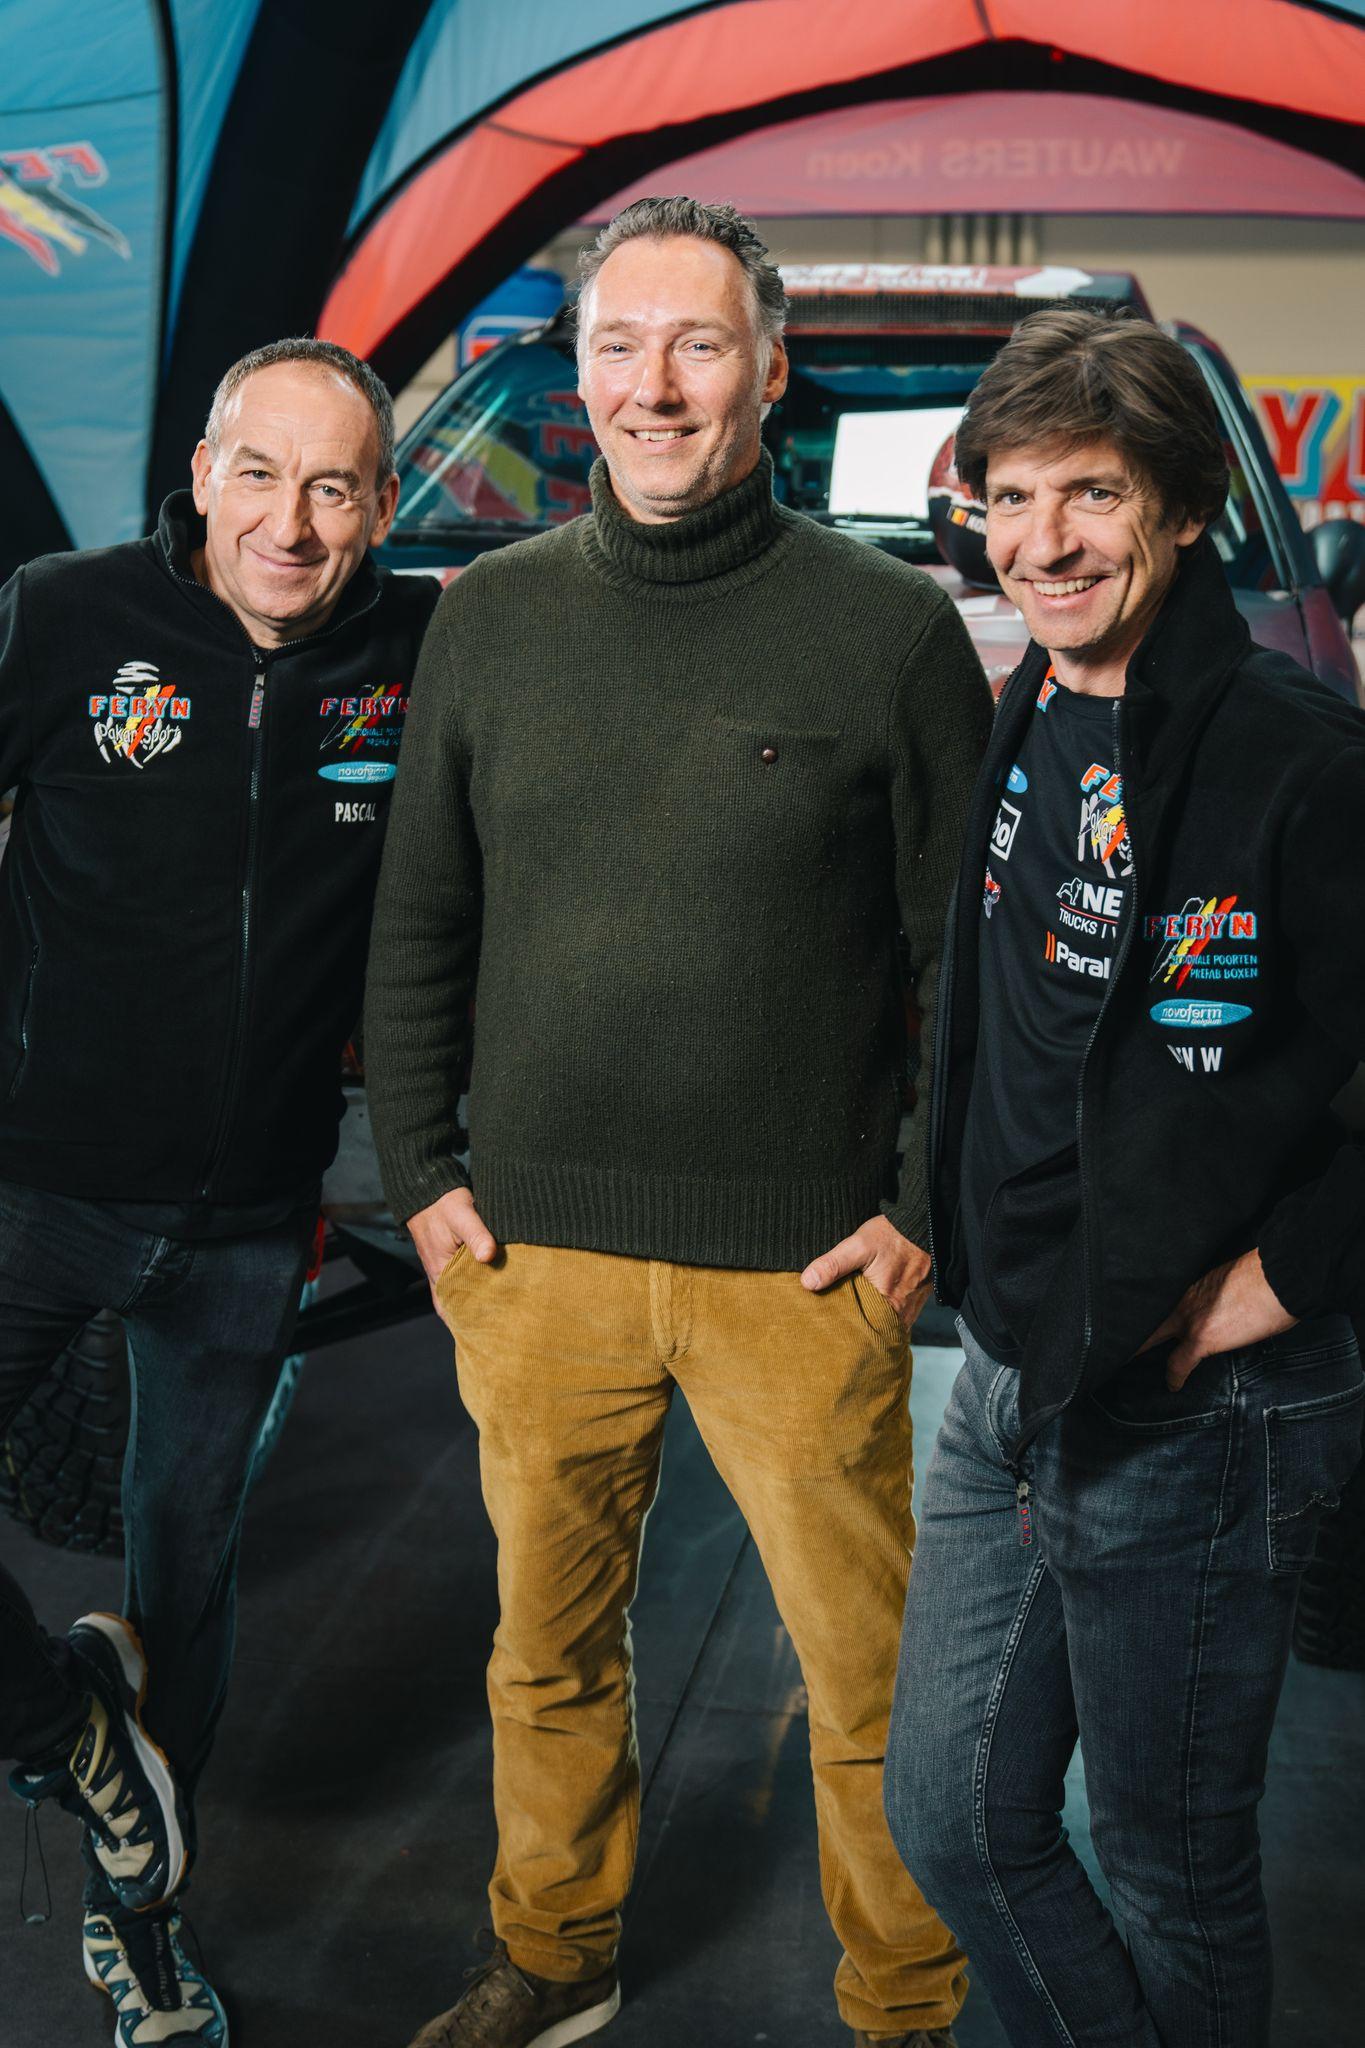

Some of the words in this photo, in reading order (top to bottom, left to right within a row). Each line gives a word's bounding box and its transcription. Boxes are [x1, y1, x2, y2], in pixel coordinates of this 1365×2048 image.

[89, 694, 191, 720] FERYN
[142, 722, 182, 750] Sport
[338, 763, 389, 780] novoferm
[334, 801, 377, 823] PASCAL
[1059, 907, 1099, 936] TRUCKS
[1144, 912, 1257, 940] FERYN
[1213, 954, 1258, 966] POORTEN
[1223, 967, 1258, 980] BOXEN
[1161, 1003, 1224, 1023] novoferm
